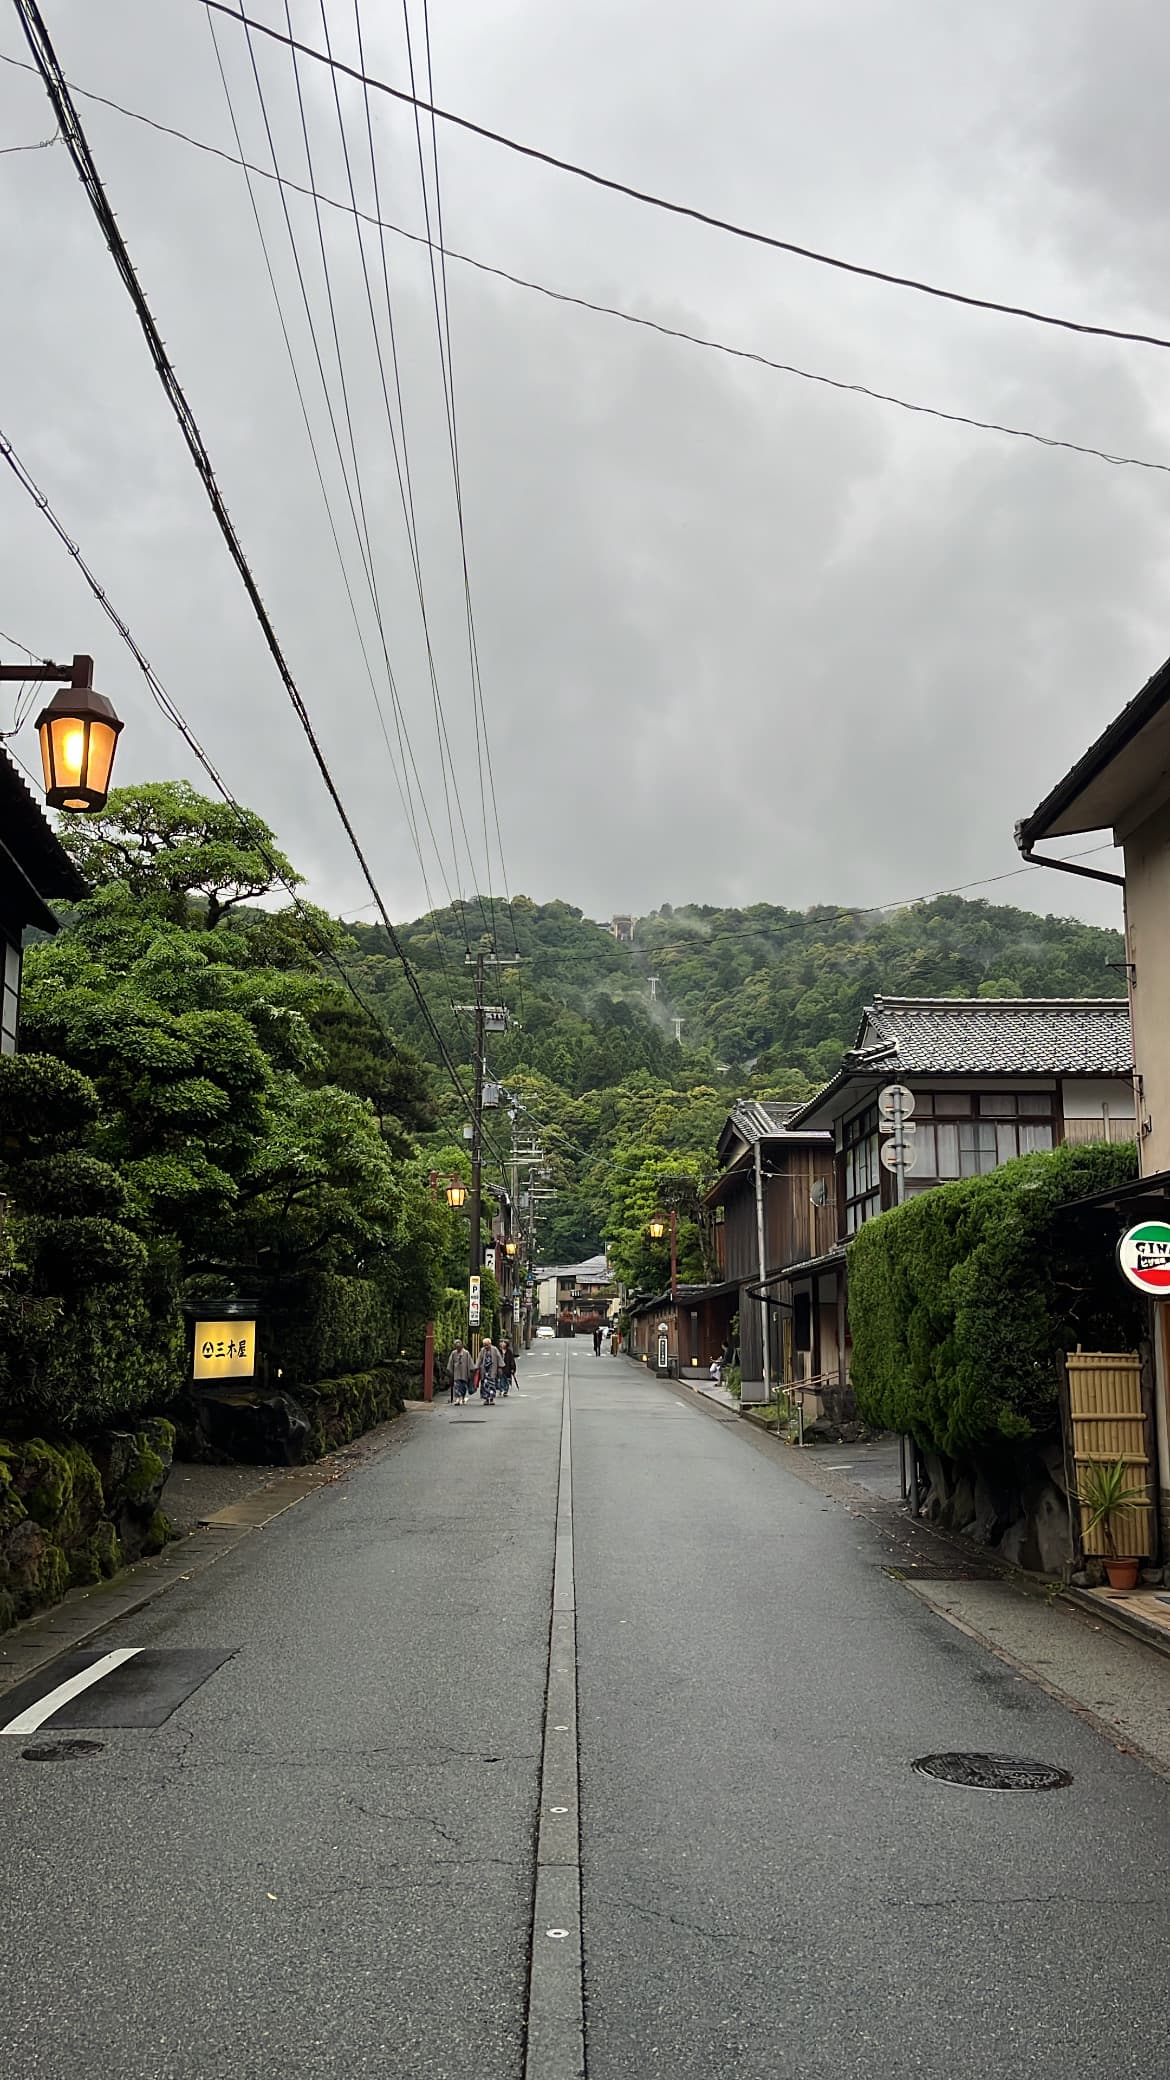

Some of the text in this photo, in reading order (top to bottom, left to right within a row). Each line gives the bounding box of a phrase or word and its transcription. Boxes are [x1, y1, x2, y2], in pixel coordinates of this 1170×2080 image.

[1135, 1242, 1170, 1254] GIN
[215, 1339, 247, 1359] 三木屋
